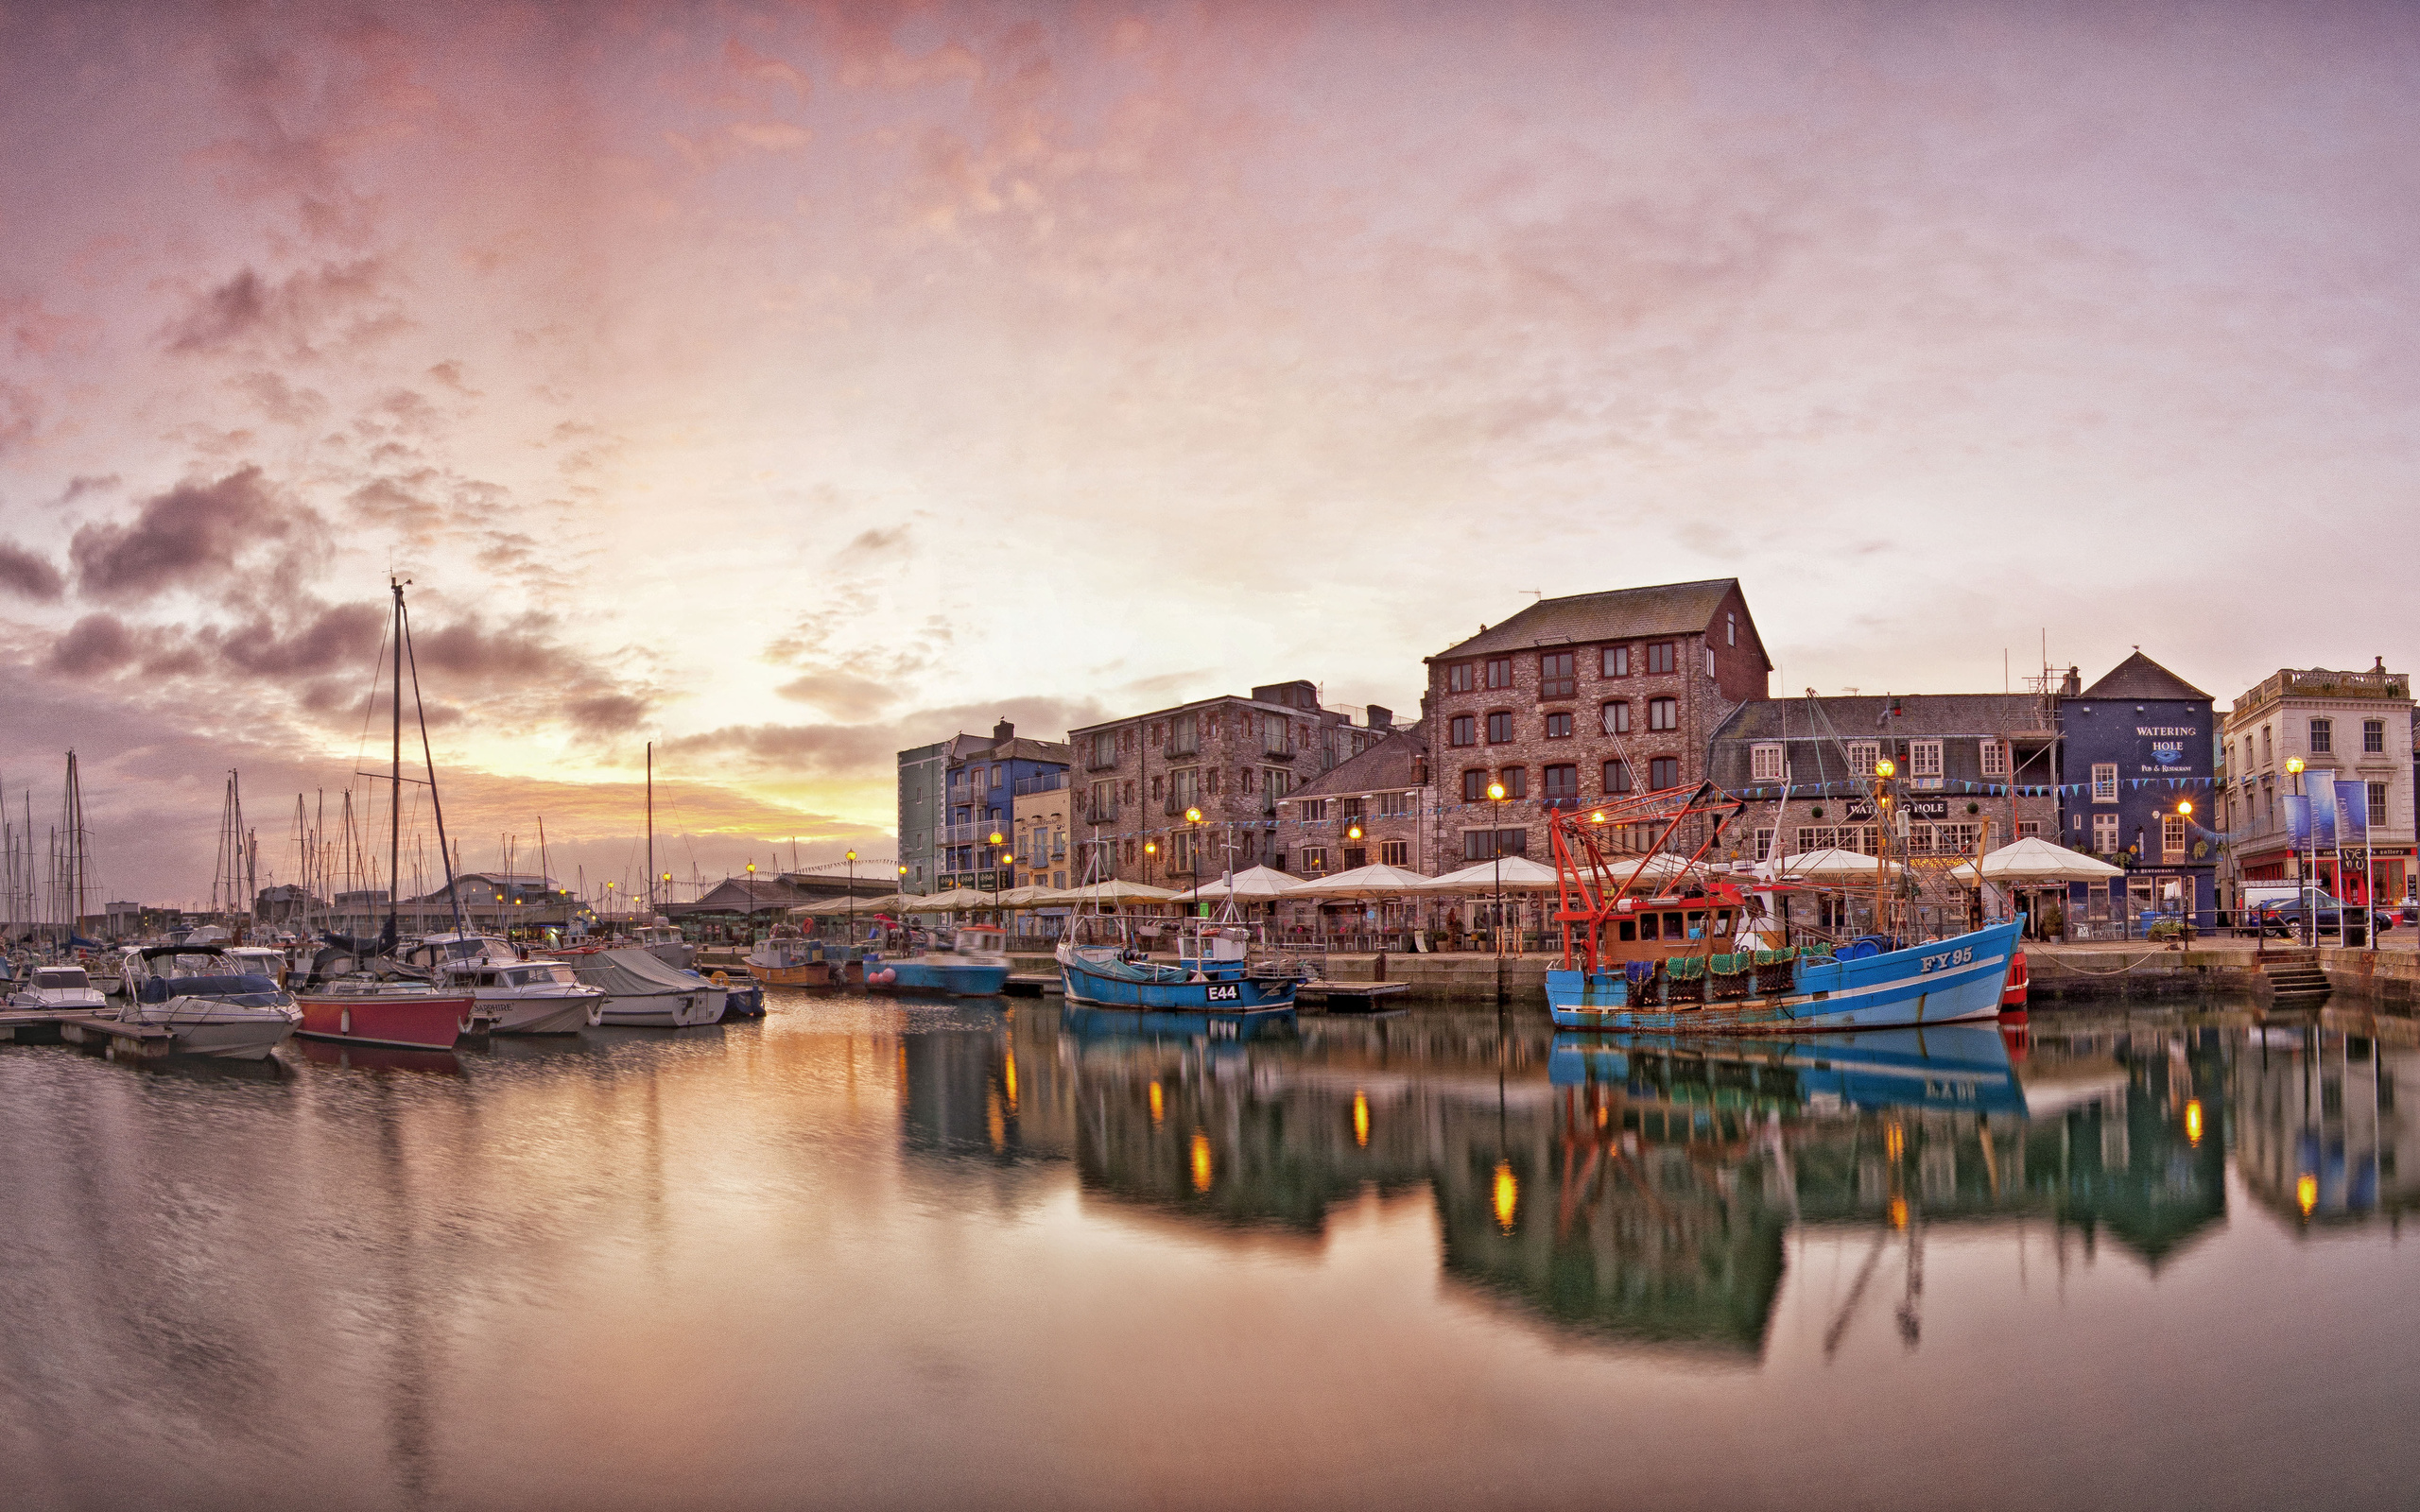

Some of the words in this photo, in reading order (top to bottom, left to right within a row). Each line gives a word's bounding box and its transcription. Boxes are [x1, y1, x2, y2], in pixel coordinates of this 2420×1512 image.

[2136, 727, 2196, 736] WATERING
[2152, 742, 2184, 750] HOLE
[1914, 803, 1945, 813] HOLE
[1921, 952, 1951, 972] FY
[1952, 946, 1973, 966] 95
[1208, 986, 1236, 1001] E44
